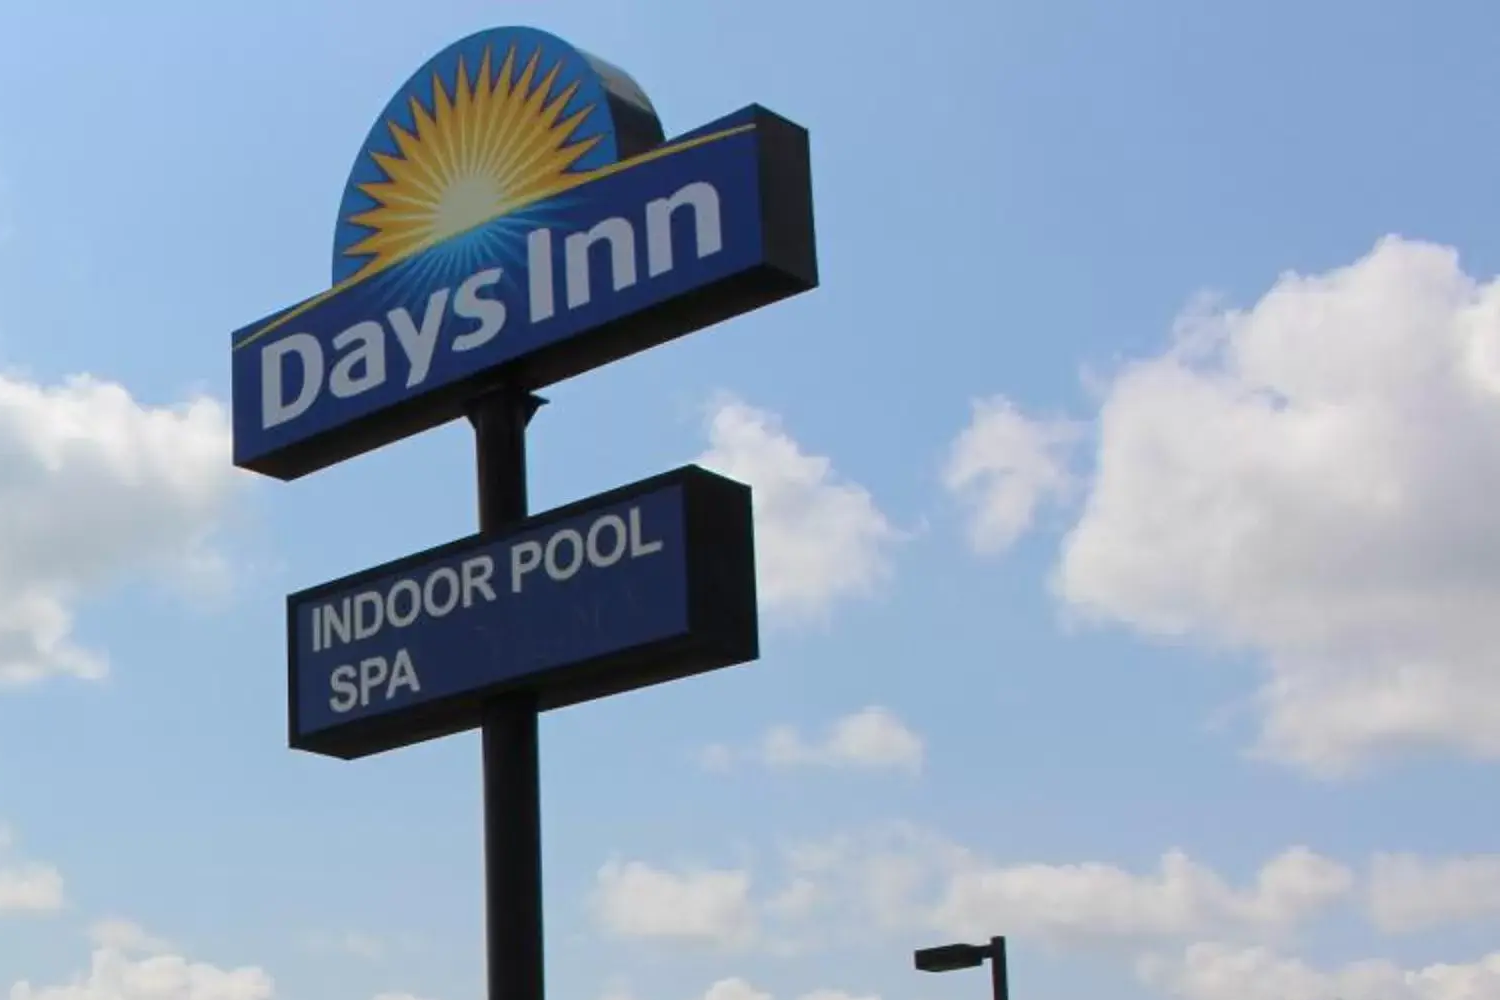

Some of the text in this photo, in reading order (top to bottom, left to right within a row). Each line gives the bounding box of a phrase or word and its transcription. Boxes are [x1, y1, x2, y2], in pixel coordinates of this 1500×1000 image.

[261, 181, 723, 430] Days Inn
[312, 506, 663, 652] INDOOR POOL
[329, 648, 421, 713] SPA
